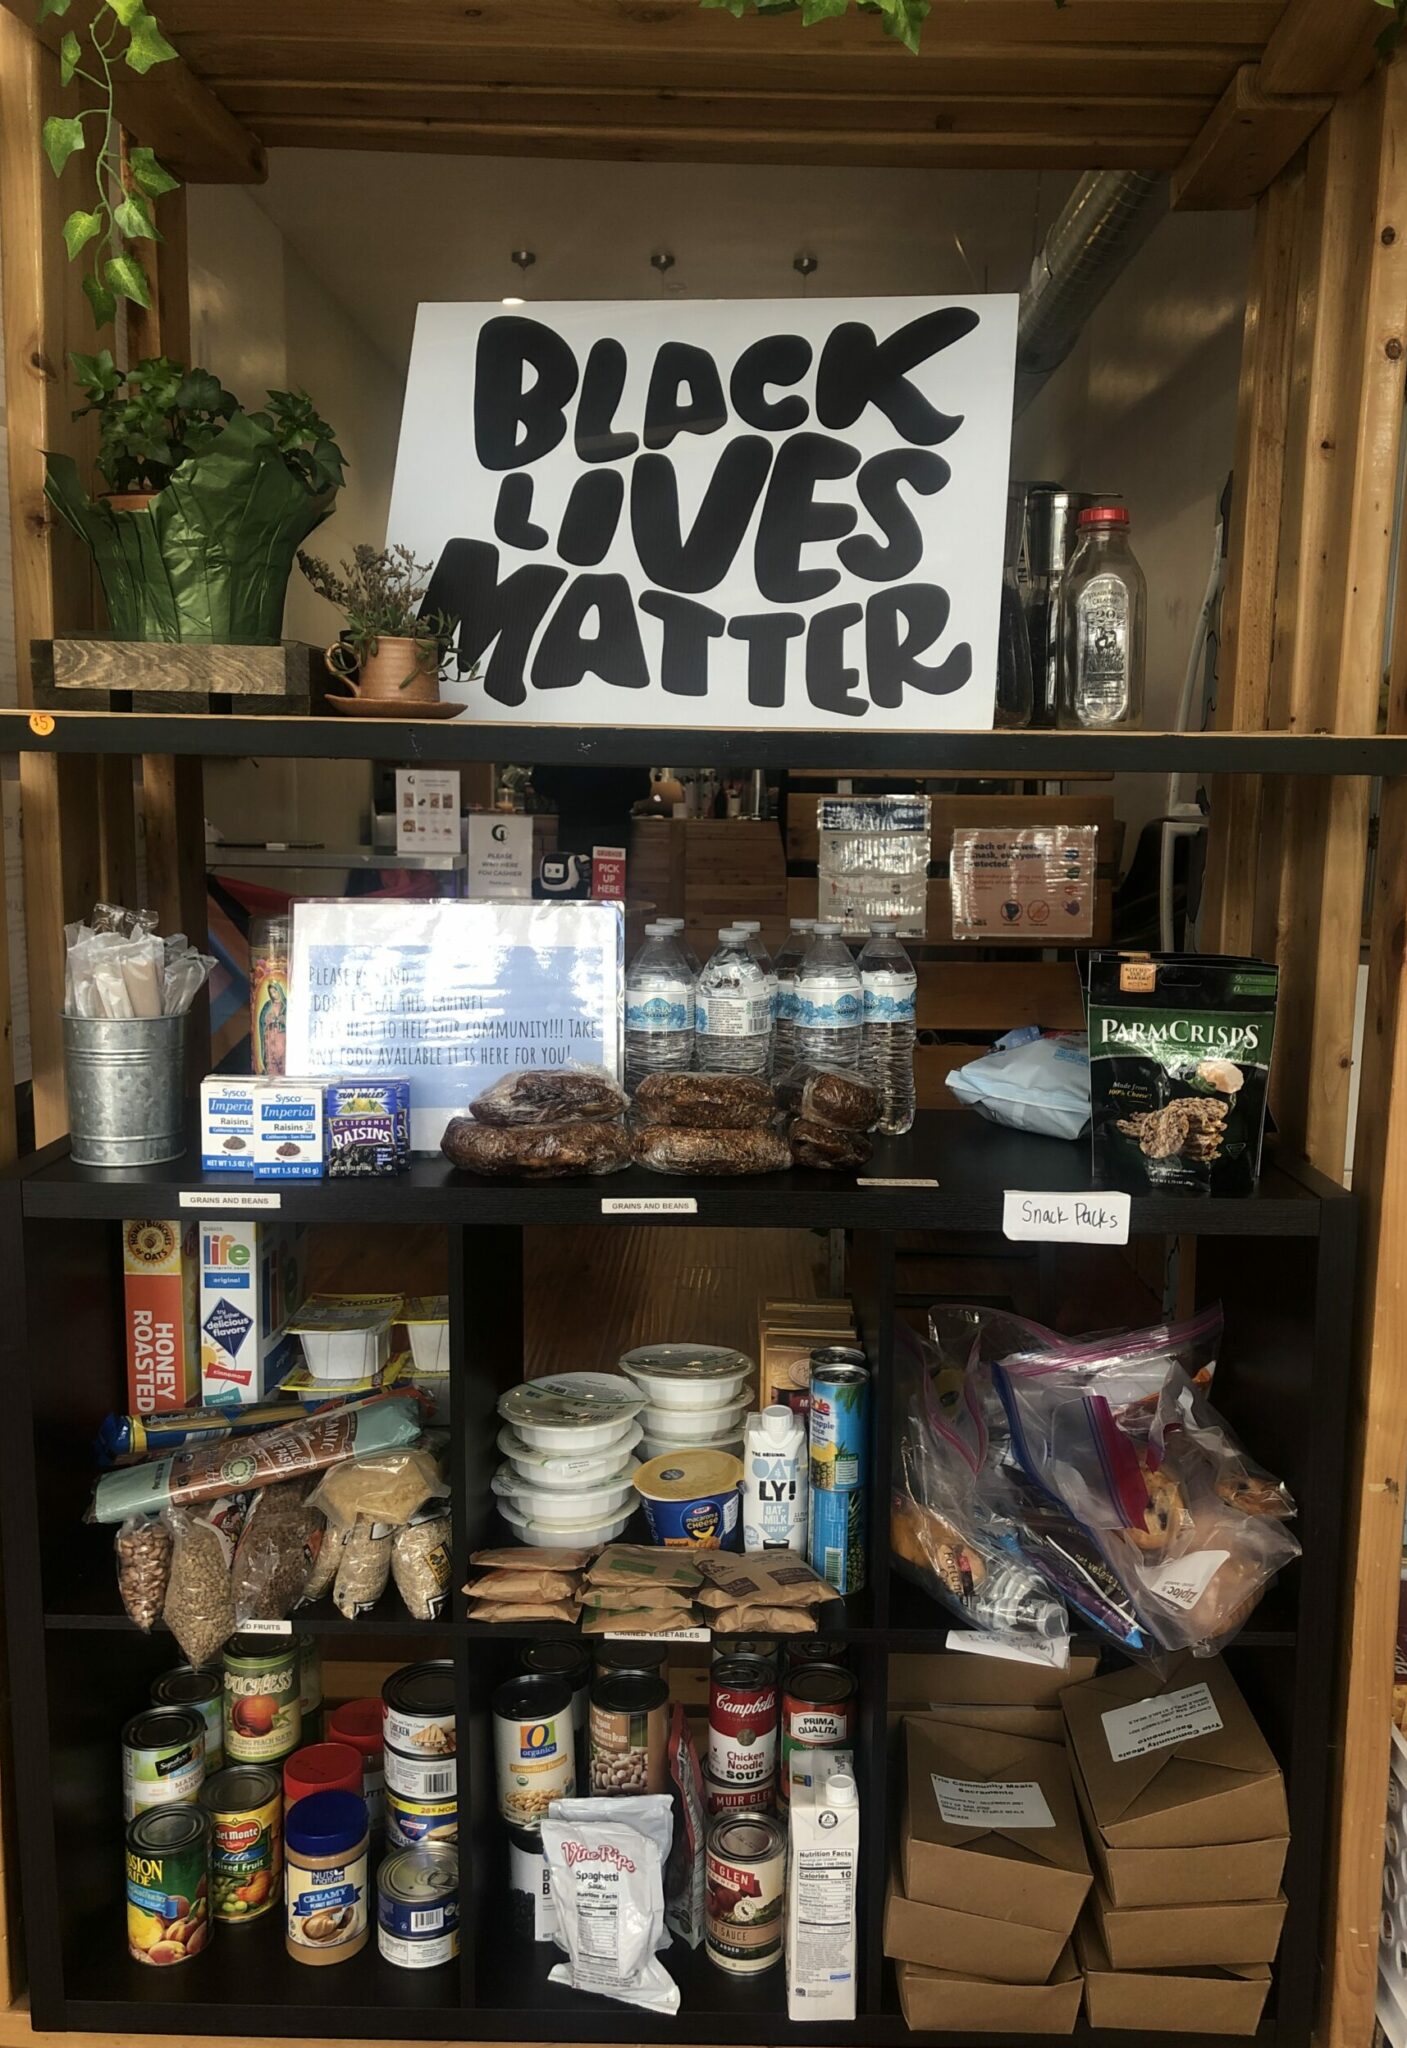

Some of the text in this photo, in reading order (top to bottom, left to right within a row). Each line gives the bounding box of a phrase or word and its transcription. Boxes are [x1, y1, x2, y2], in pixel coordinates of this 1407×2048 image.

[474, 306, 980, 471] BLACK
[494, 431, 952, 603] LIVES
[418, 537, 973, 717] MATTER
[598, 863, 620, 873] PICK
[602, 874, 616, 884] UP
[597, 885, 621, 895] HERE
[309, 966, 350, 986] PLEASE
[400, 994, 426, 1012] THIS
[381, 1021, 397, 1038] TO
[402, 1020, 429, 1038] HELP
[466, 1019, 563, 1038] COMMUNITY!!!
[340, 1047, 373, 1065] FOOD
[377, 1047, 442, 1065] AVAILABLE
[447, 1047, 458, 1064] IT
[464, 1047, 476, 1065] IS
[481, 1046, 509, 1064] HERE
[515, 1046, 536, 1064] FOR
[541, 1045, 571, 1064] YOU!
[222, 1088, 247, 1098] Sysco
[1108, 1089, 1126, 1097] 100%
[1112, 1081, 1148, 1092] Made from
[275, 1094, 301, 1104] Sysco
[356, 1091, 387, 1099] VALLEY
[210, 1100, 254, 1114] Imperia
[264, 1106, 315, 1119] Imperial
[220, 1117, 249, 1126] Raisins
[274, 1123, 304, 1131] Raisins
[333, 1127, 392, 1150] RAISINS
[302, 1166, 311, 1175] (43
[311, 1166, 319, 1175] g)
[612, 1202, 642, 1210] GRAINS
[662, 1202, 690, 1210] BEANS
[1021, 1201, 1118, 1229] Snack Packs
[144, 1250, 168, 1261] OATS
[203, 1234, 251, 1266] life
[213, 1277, 241, 1285] original
[207, 1317, 249, 1330] delicious
[212, 1326, 246, 1337] flavors
[133, 1309, 156, 1412] ROASTED
[154, 1322, 176, 1400] HONEY
[213, 1369, 246, 1380] cinnamon
[752, 1458, 799, 1480] OAT
[759, 1480, 796, 1502] LY!
[765, 1515, 786, 1525] MILK
[1167, 1586, 1198, 1603] Ziploc
[803, 1717, 834, 1726] PRIMA
[1118, 1722, 1222, 1758] Trio Community Meals
[1138, 1723, 1193, 1745] Sacramento
[522, 1745, 555, 1757] organics
[727, 1750, 765, 1761] Chicken
[727, 1760, 764, 1770] Noodle
[726, 1769, 764, 1780] SOUP
[934, 1776, 950, 1784] Trio
[952, 1781, 1003, 1789] Community
[717, 1793, 745, 1806] MUIR
[438, 1805, 457, 1814] MOR
[216, 1823, 258, 1840] Del Monte
[213, 1859, 264, 1872] Mixed Fruit
[313, 1870, 334, 1880] NUTS
[575, 1870, 619, 1883] Spaghetti
[720, 1864, 750, 1886] GLEN
[840, 1870, 852, 1878] 10
[303, 1886, 348, 1904] CREAMY
[720, 1927, 748, 1942] SAUCE
[720, 1943, 740, 1953] ADDED
